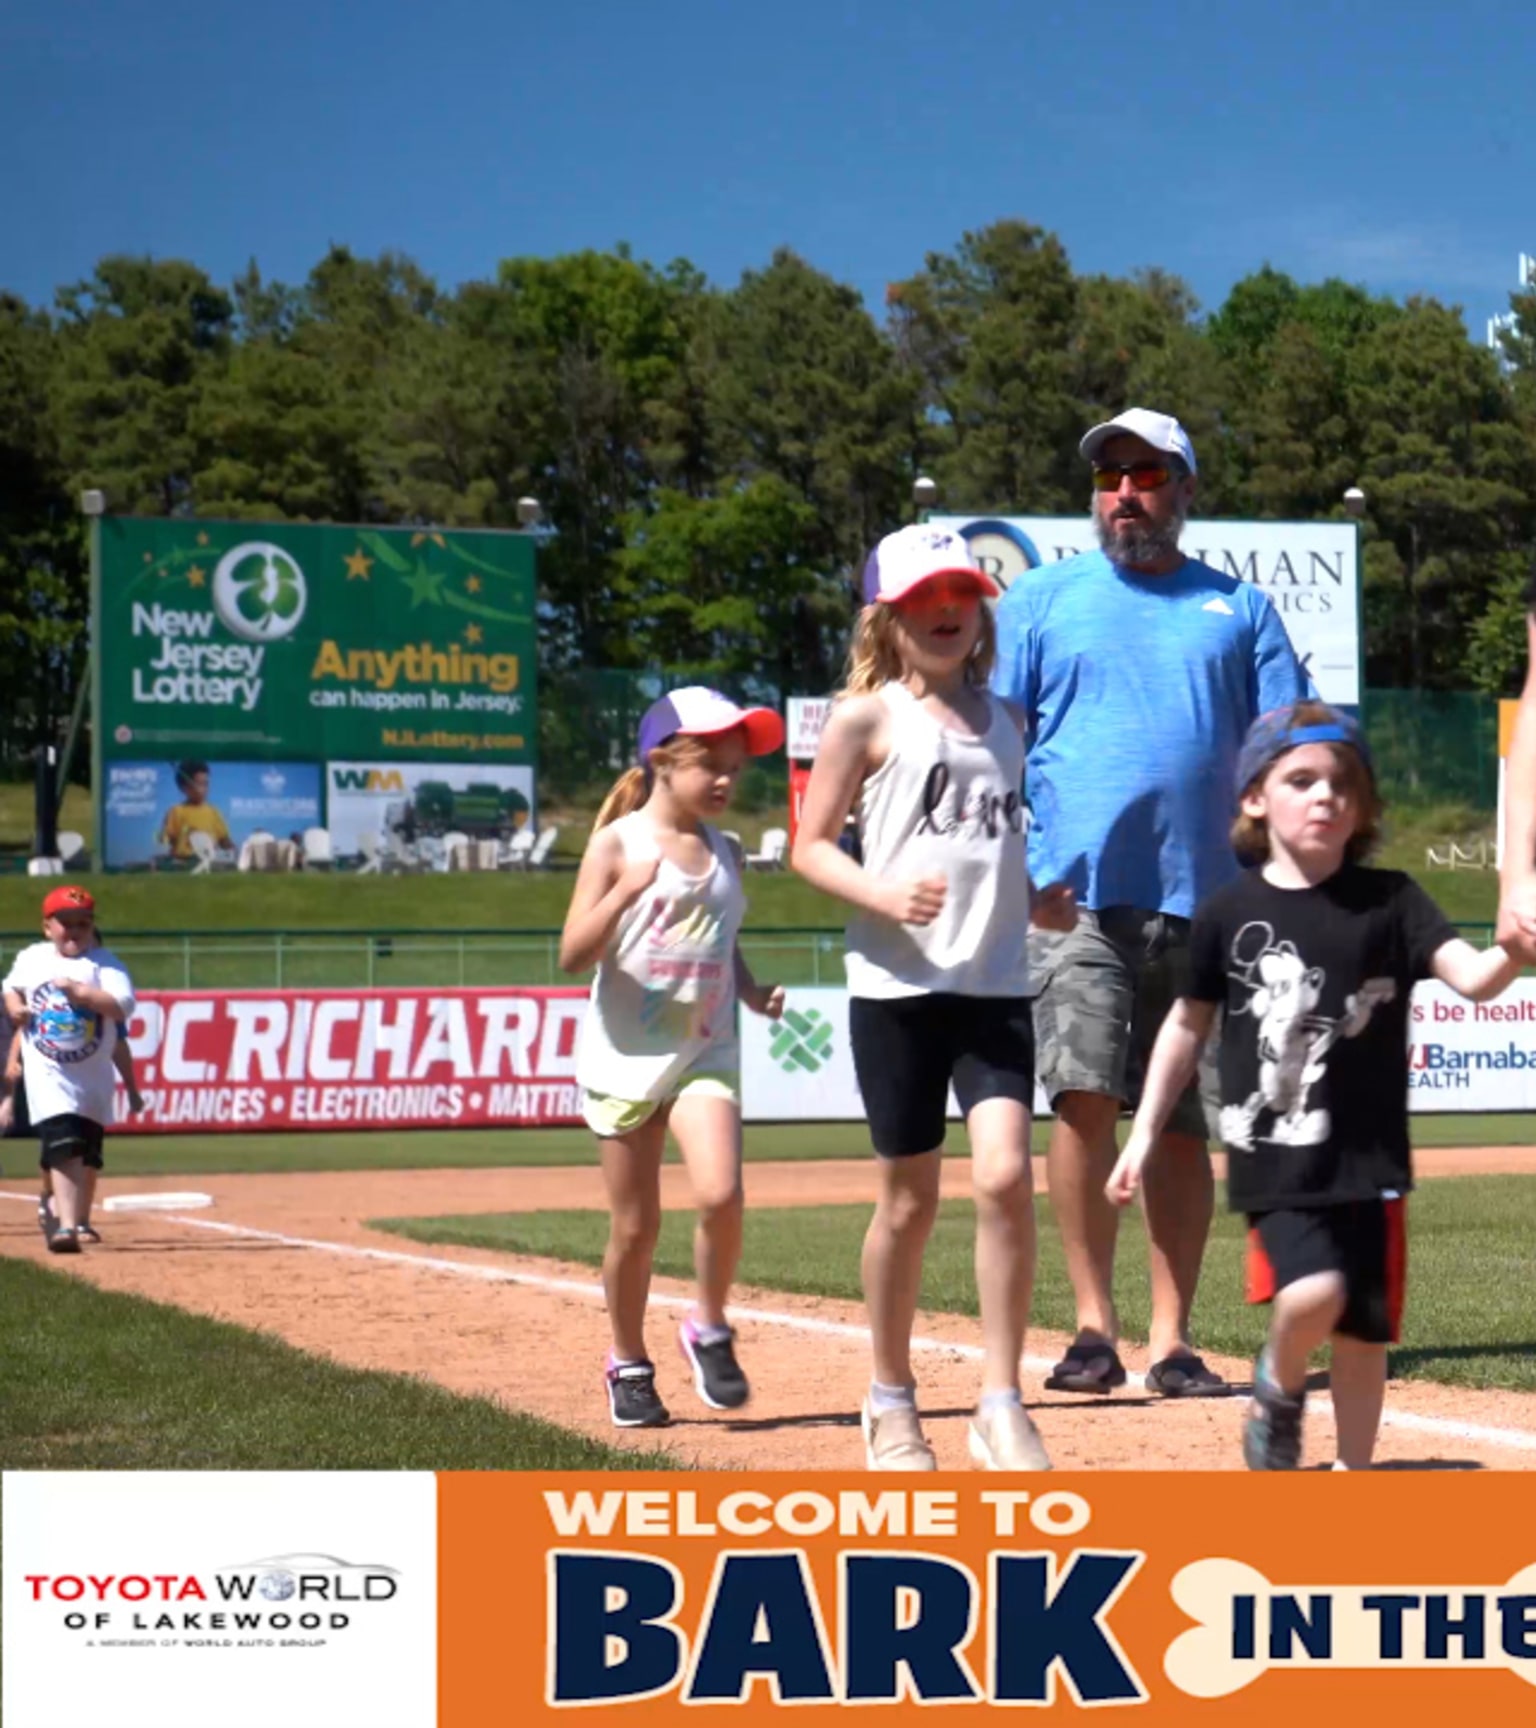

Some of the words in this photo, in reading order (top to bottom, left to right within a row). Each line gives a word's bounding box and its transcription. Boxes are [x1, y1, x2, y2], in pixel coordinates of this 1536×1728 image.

[132, 602, 214, 637] New
[150, 636, 264, 677] Jersey
[311, 639, 519, 692] Anything
[132, 668, 262, 711] Lottery
[309, 689, 346, 707] can
[350, 687, 426, 712] happen
[431, 689, 449, 710] in
[333, 769, 402, 790] WM
[1433, 1001, 1465, 1022] be
[226, 998, 588, 1082] RICHARD
[289, 1081, 464, 1119] ELECTRONICS
